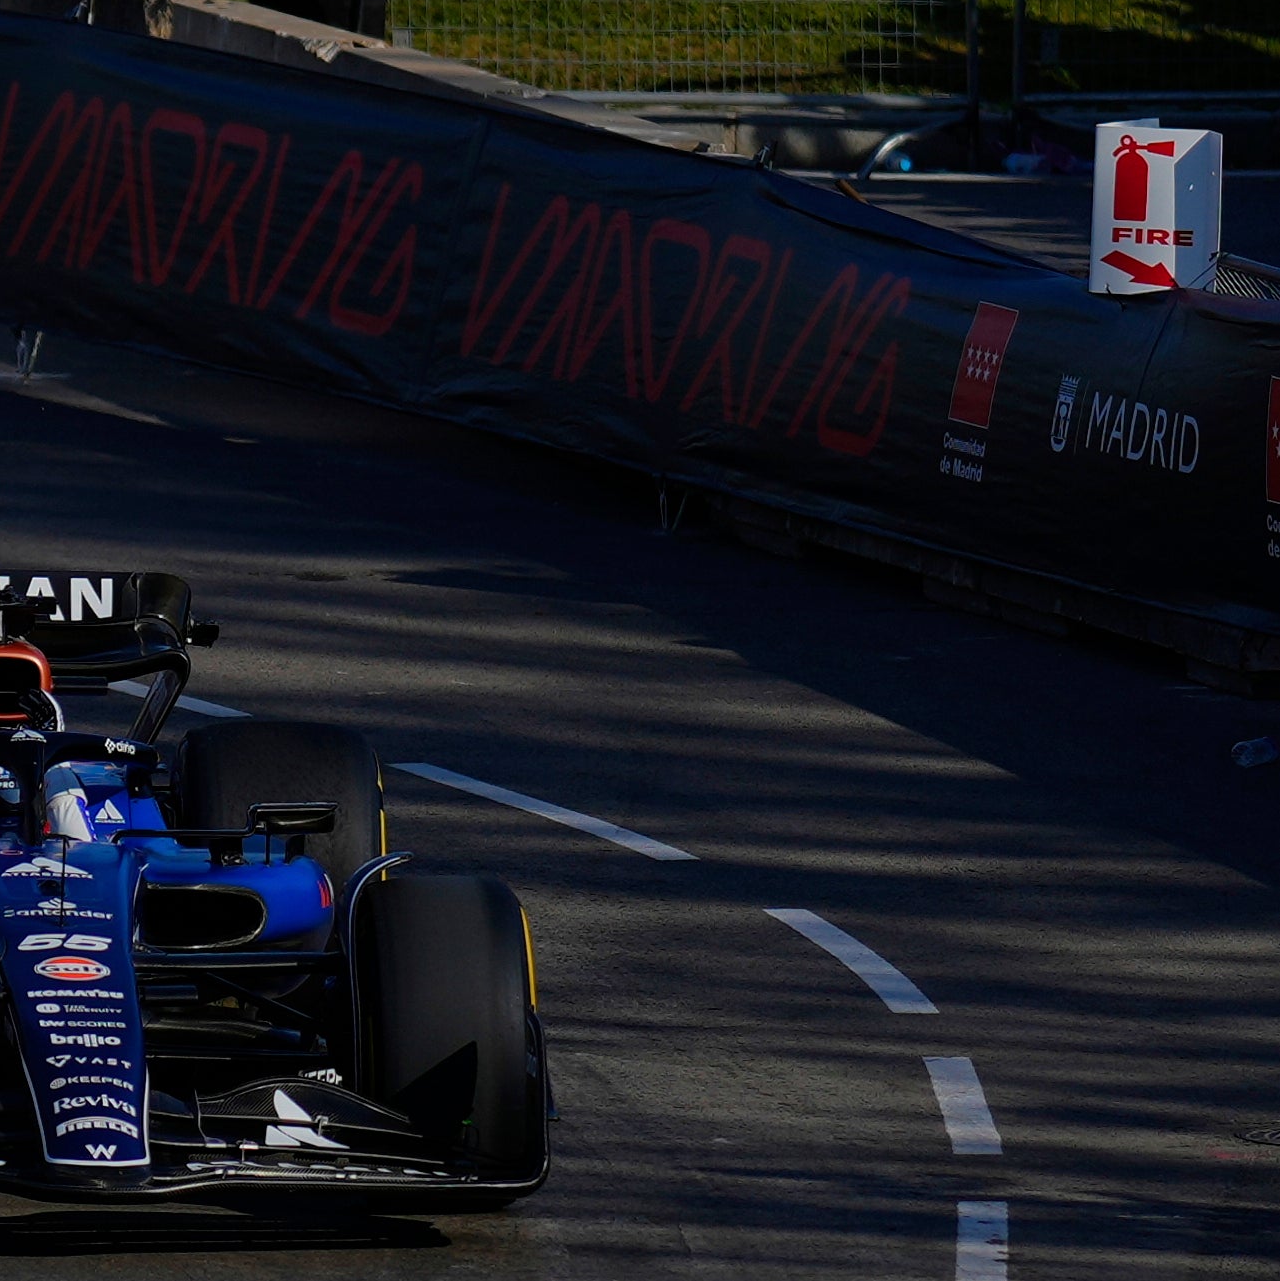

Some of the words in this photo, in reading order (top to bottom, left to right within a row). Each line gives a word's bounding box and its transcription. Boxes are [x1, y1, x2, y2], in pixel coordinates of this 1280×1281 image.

[1111, 227, 1195, 246] FIRE
[1083, 390, 1202, 476] MADRID
[942, 430, 988, 458] Comunidad
[938, 458, 952, 476] de
[952, 459, 984, 483] Madrid
[1266, 513, 1280, 534] Co
[3, 907, 114, 920] Santander
[16, 933, 114, 952] 55
[40, 964, 103, 975] Gulf
[26, 989, 125, 1000] KOMATSU
[49, 1033, 122, 1048] brillio
[73, 1056, 133, 1070] VAST
[67, 1075, 135, 1092] KEEPER
[52, 1093, 138, 1118] Reviva
[55, 1115, 139, 1140] PIRELLI
